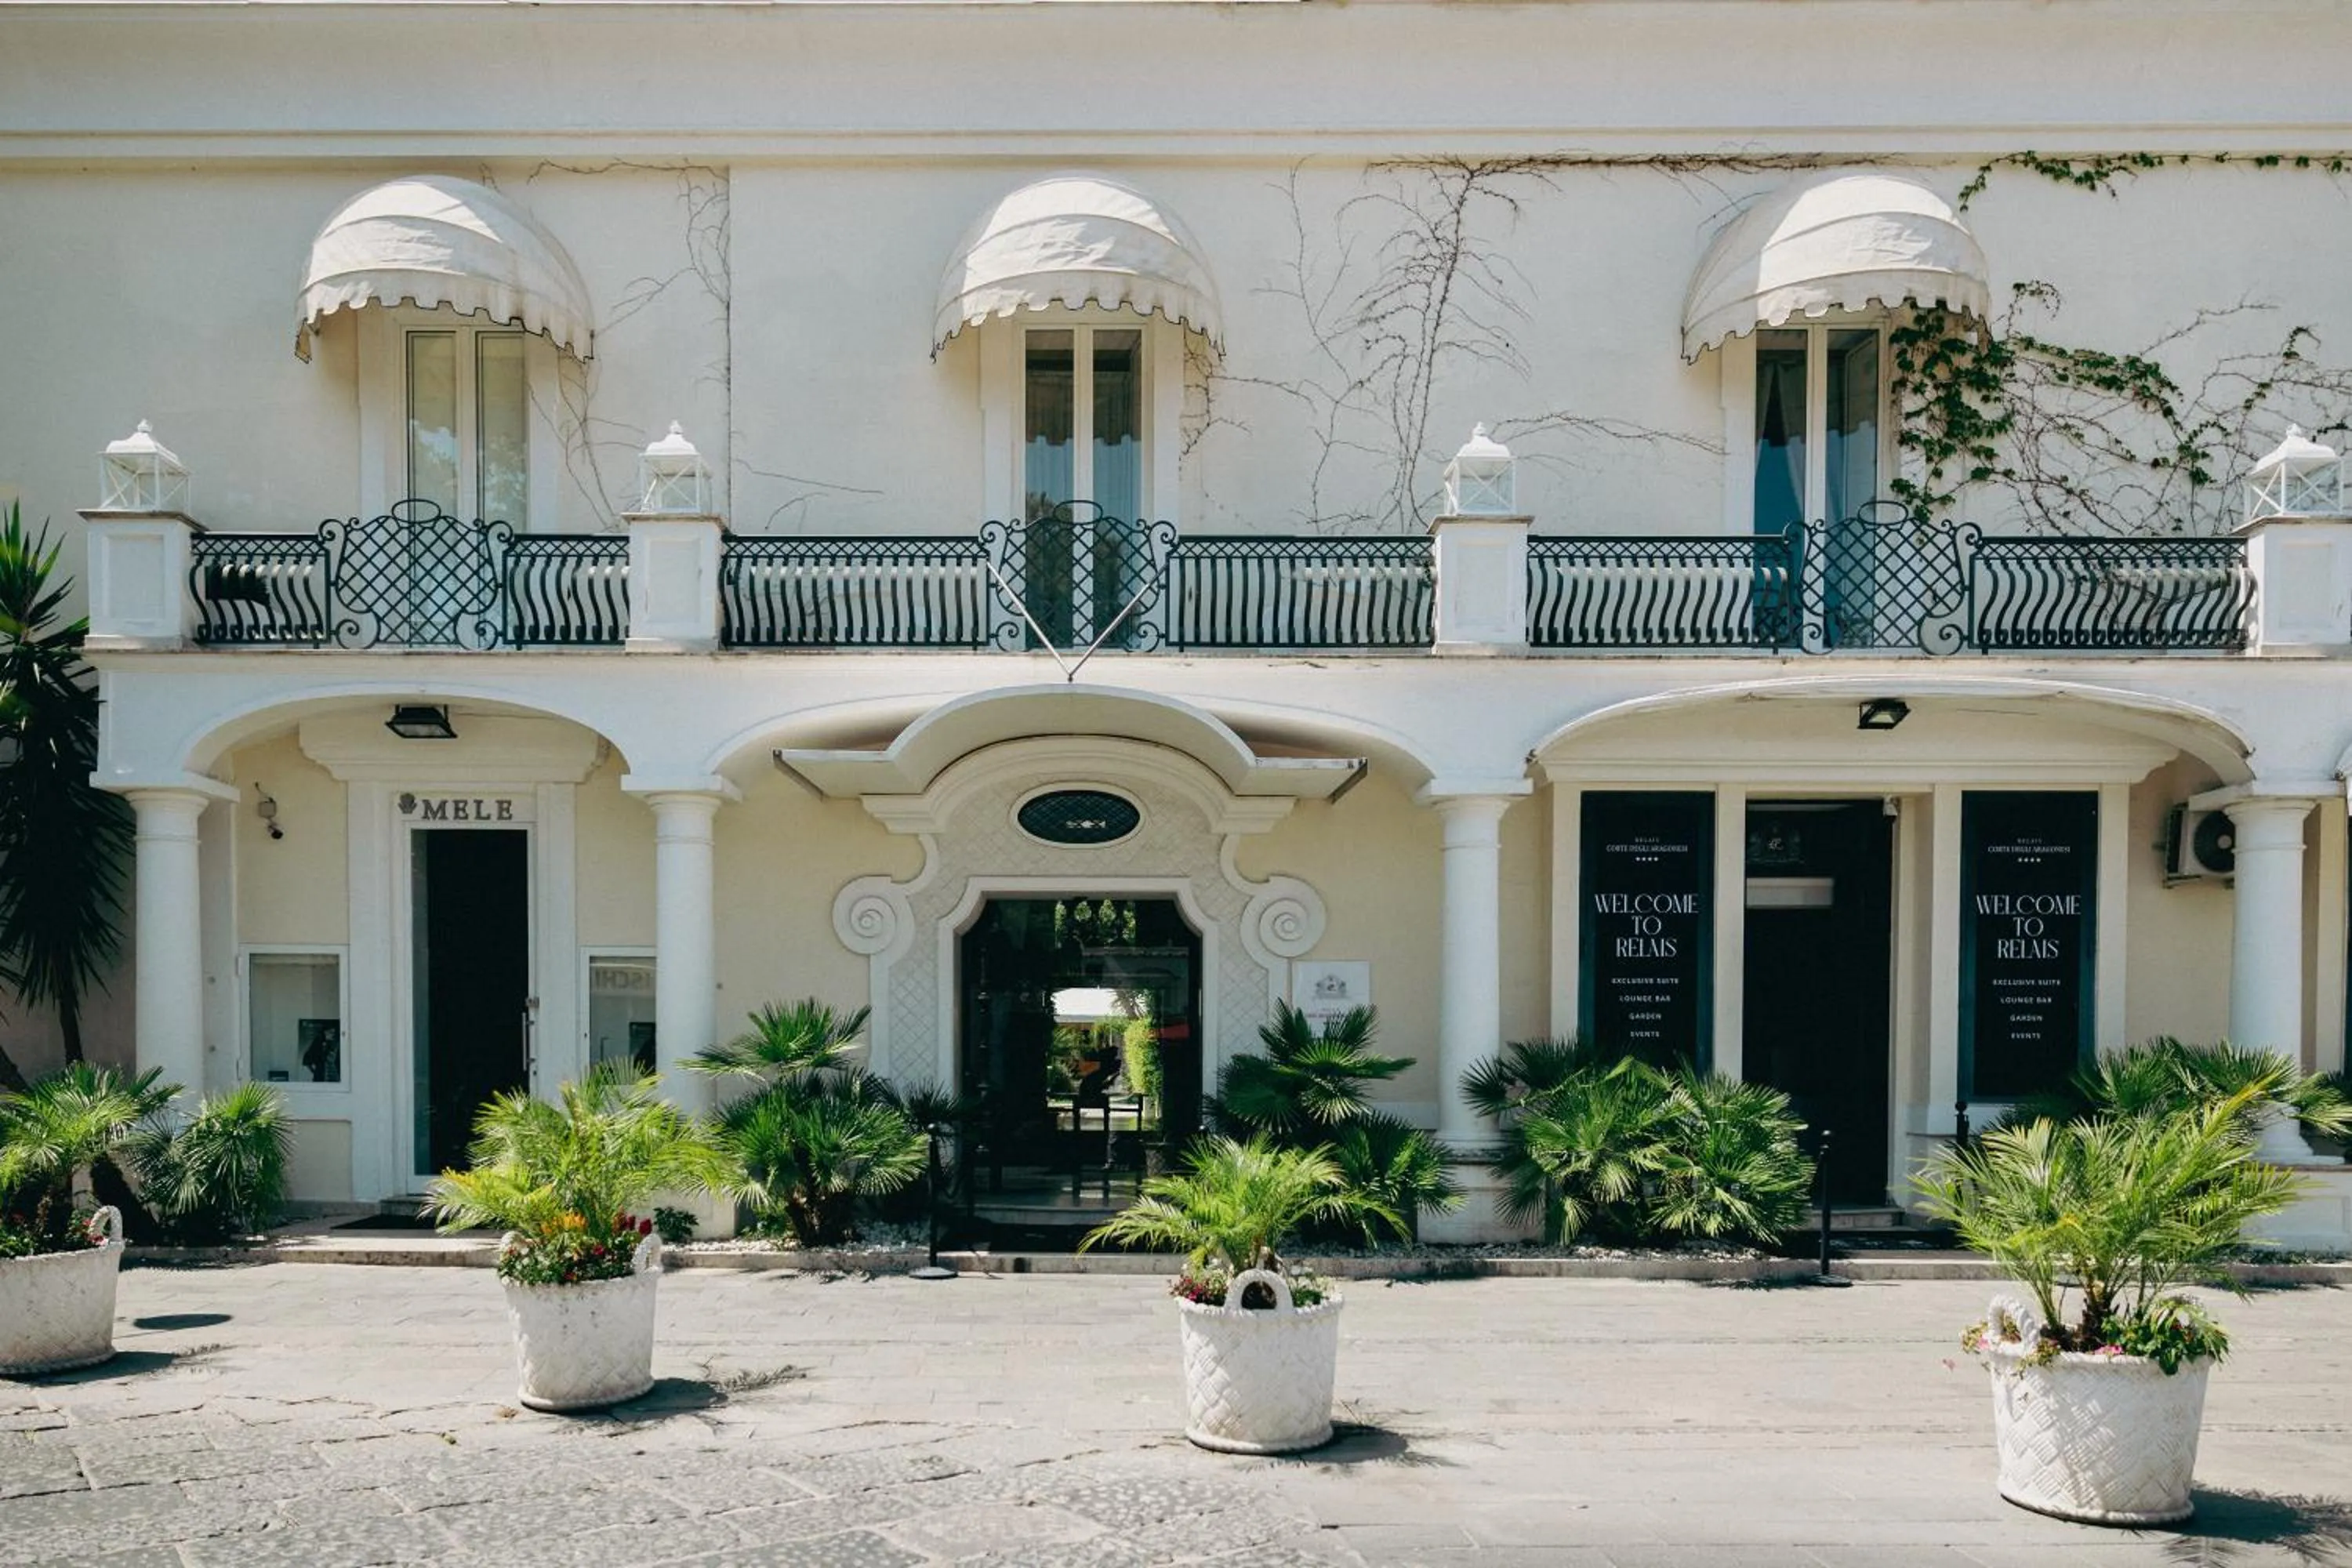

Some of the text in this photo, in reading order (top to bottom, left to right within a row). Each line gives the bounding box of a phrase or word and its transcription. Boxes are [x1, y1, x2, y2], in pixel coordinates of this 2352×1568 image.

[421, 799, 513, 820] MELE
[1595, 893, 1699, 914] WELCOME
[1976, 895, 2082, 915] WELCOME
[1632, 915, 1661, 935] TO
[2013, 916, 2044, 937] TO
[1616, 938, 1677, 957] RELAIS
[1998, 939, 2060, 959] RELAIS
